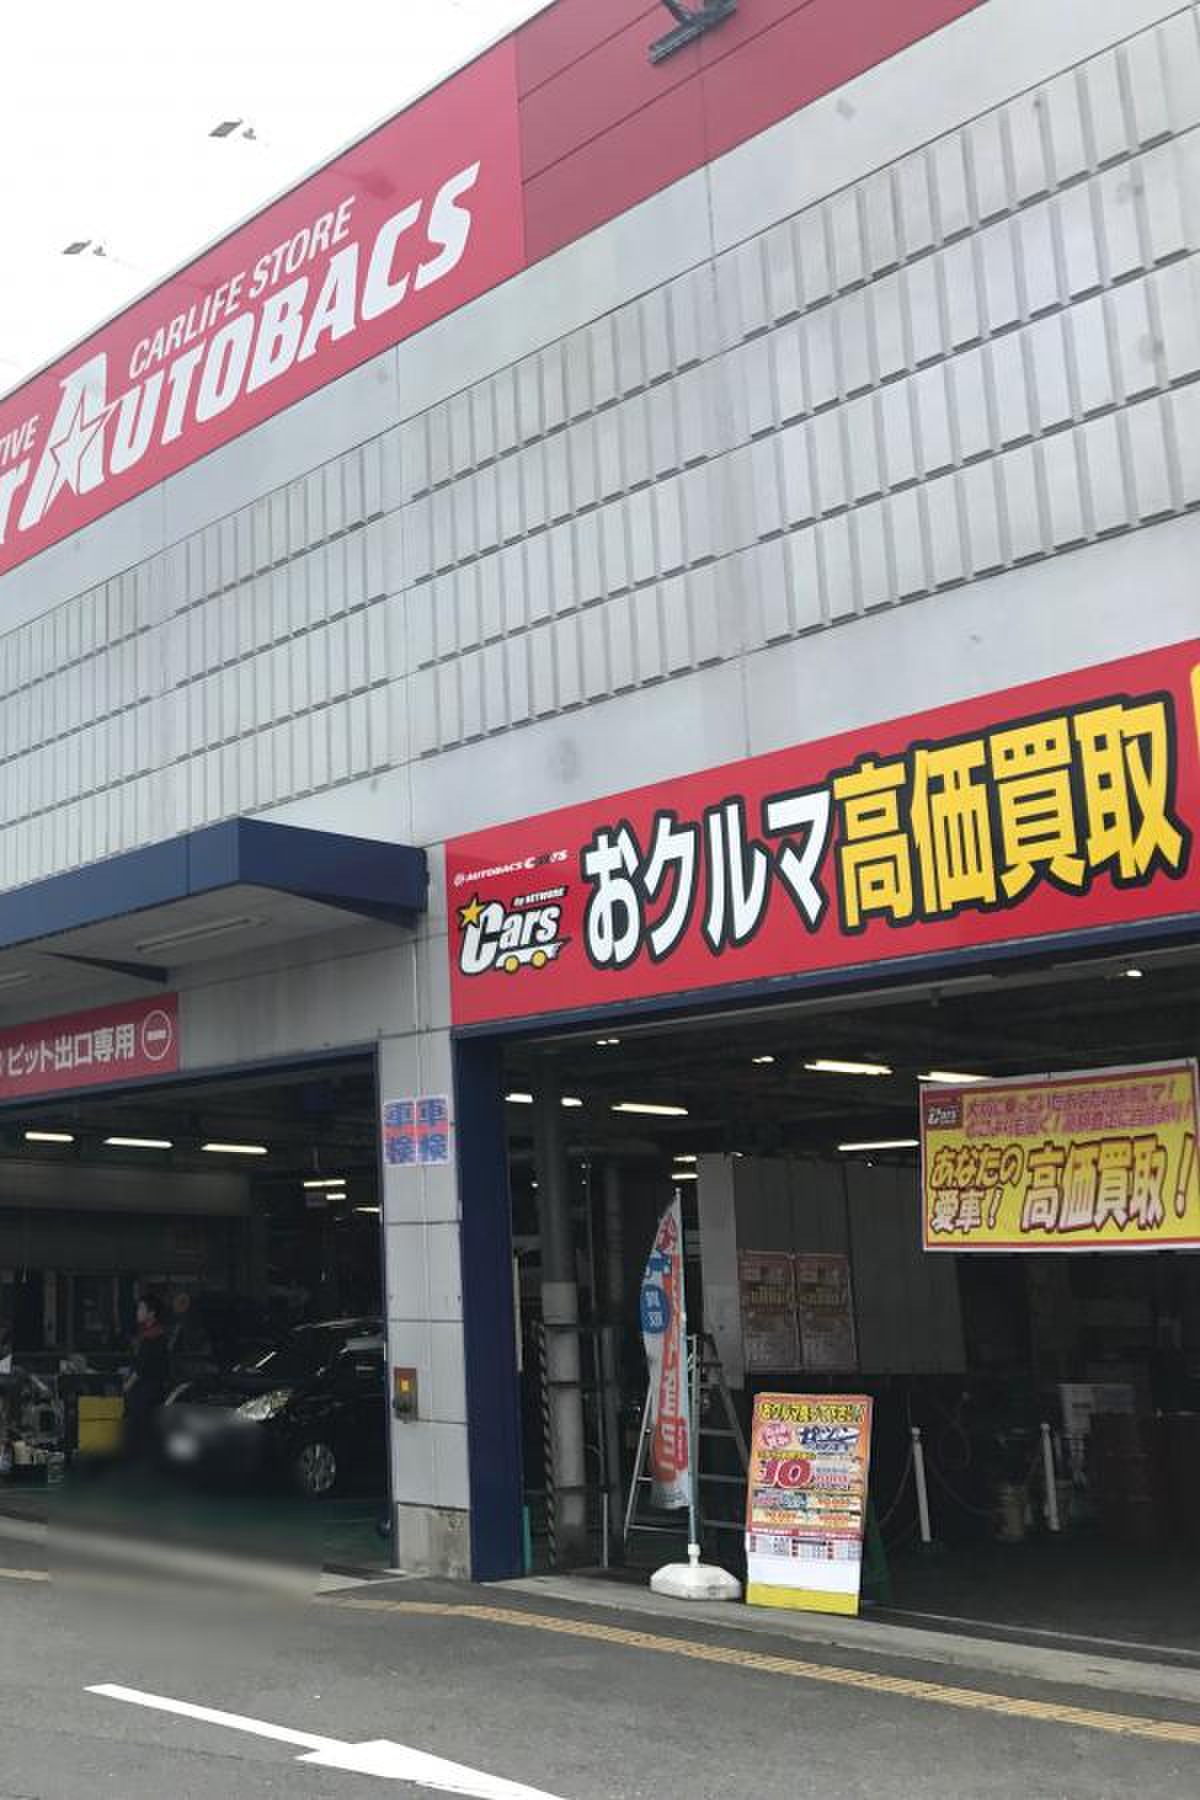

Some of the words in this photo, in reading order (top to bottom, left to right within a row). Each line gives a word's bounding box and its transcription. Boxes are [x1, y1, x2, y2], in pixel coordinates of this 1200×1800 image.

[18, 159, 481, 530] AUTOBACS
[128, 278, 246, 380] CARLIFE
[248, 195, 356, 299] STORE
[460, 901, 562, 974] Cars
[582, 700, 1184, 964] おクルマ高価買取
